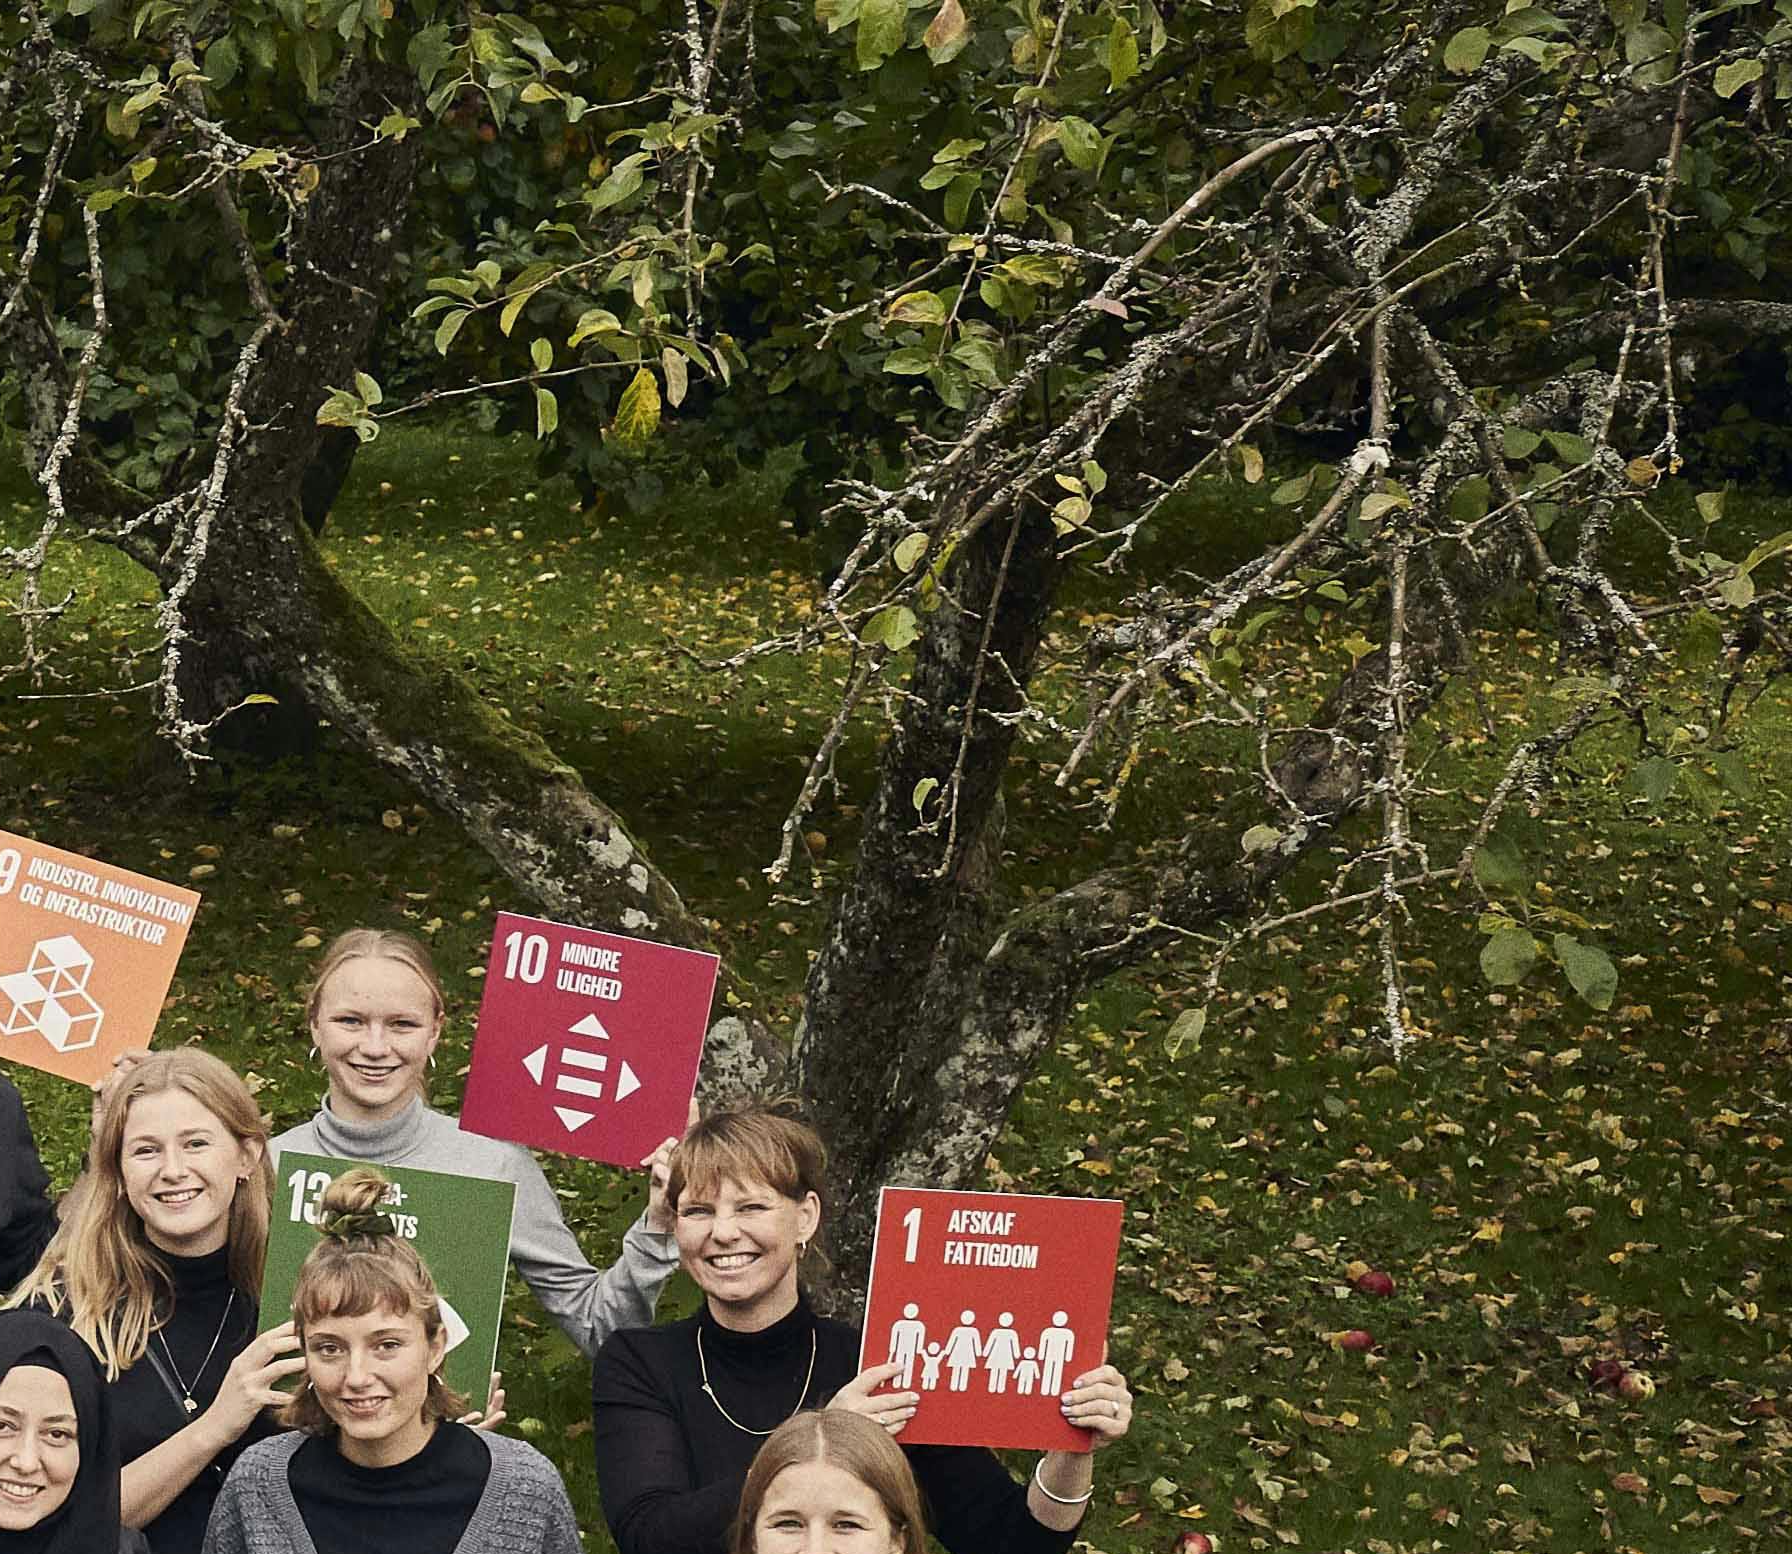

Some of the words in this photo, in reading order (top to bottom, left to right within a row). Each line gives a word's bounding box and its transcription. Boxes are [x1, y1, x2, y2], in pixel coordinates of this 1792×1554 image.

[19, 883, 42, 906] OG
[43, 889, 167, 945] INFRASTRUKTUR
[27, 857, 98, 897] INDUSTRI,
[100, 880, 191, 925] INNOVATION
[504, 931, 548, 984] 10
[561, 941, 622, 973] MINDRE
[556, 969, 623, 1001] ULIGHED
[288, 1169, 331, 1225] 13
[947, 1210, 1016, 1236] AFSKAF
[903, 1207, 922, 1263] 1
[943, 1241, 1039, 1269] FATTIGDOM
